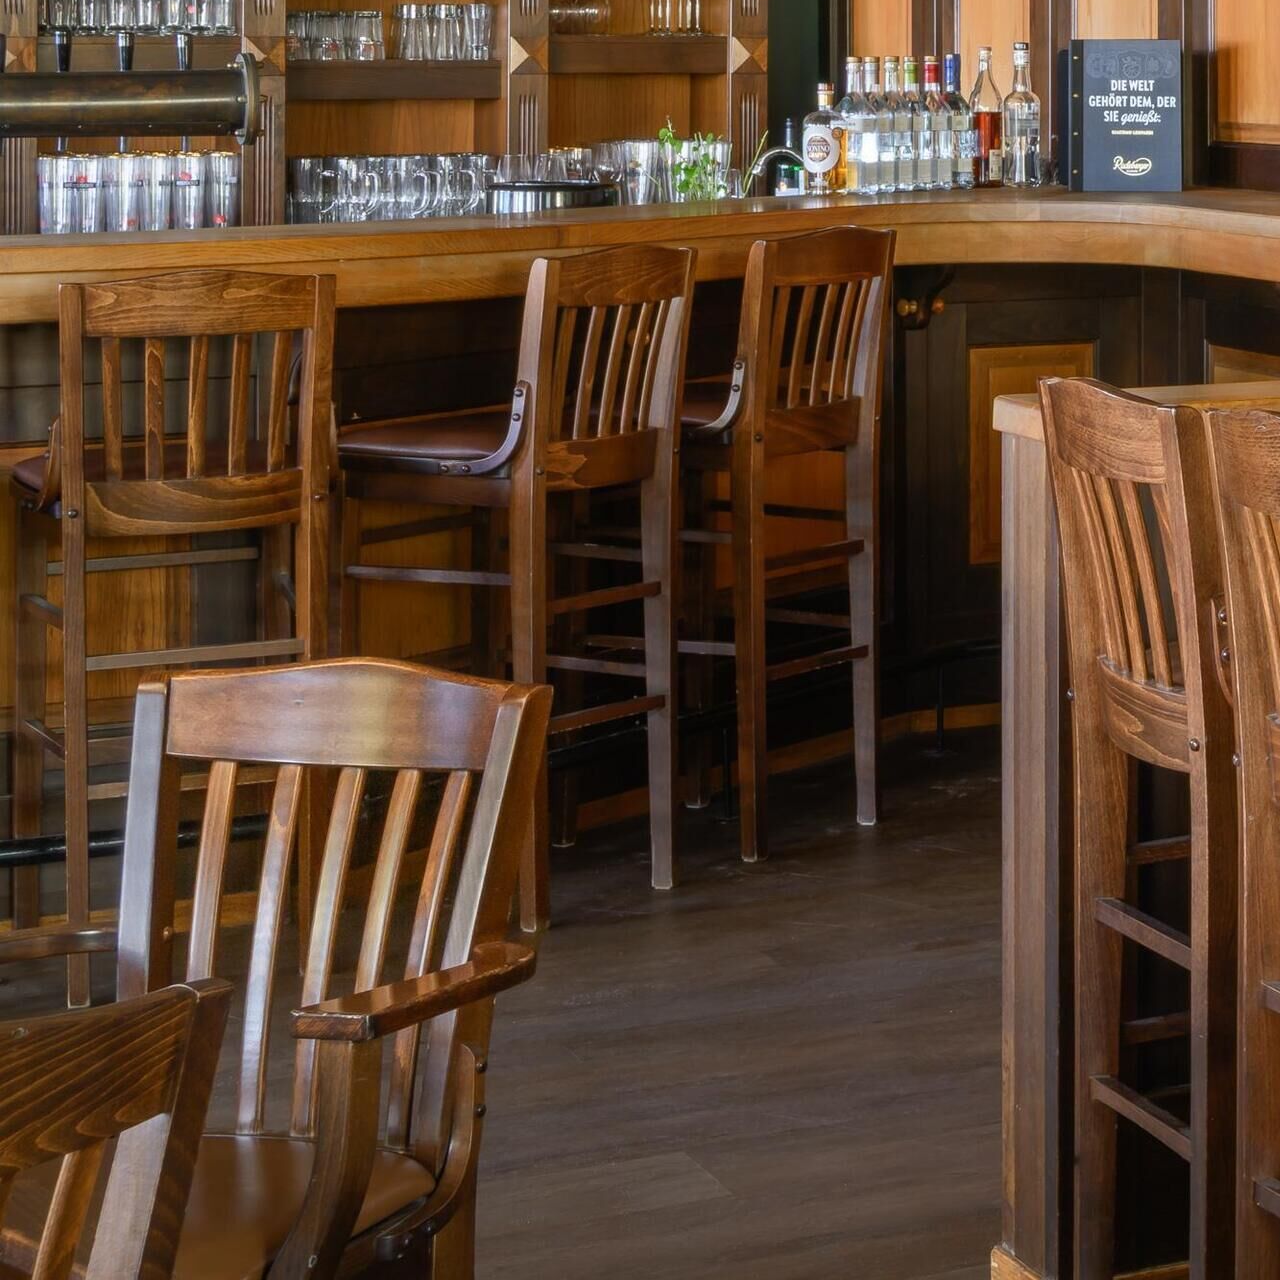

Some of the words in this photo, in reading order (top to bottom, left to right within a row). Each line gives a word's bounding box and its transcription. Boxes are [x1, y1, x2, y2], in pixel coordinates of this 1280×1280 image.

[1110, 80, 1128, 91] DIE
[1129, 80, 1155, 92] WELT
[1089, 93, 1128, 108] GEHÖRT
[1129, 96, 1155, 109] DEM,
[1156, 96, 1176, 108] DER
[1103, 111, 1119, 122] SIE
